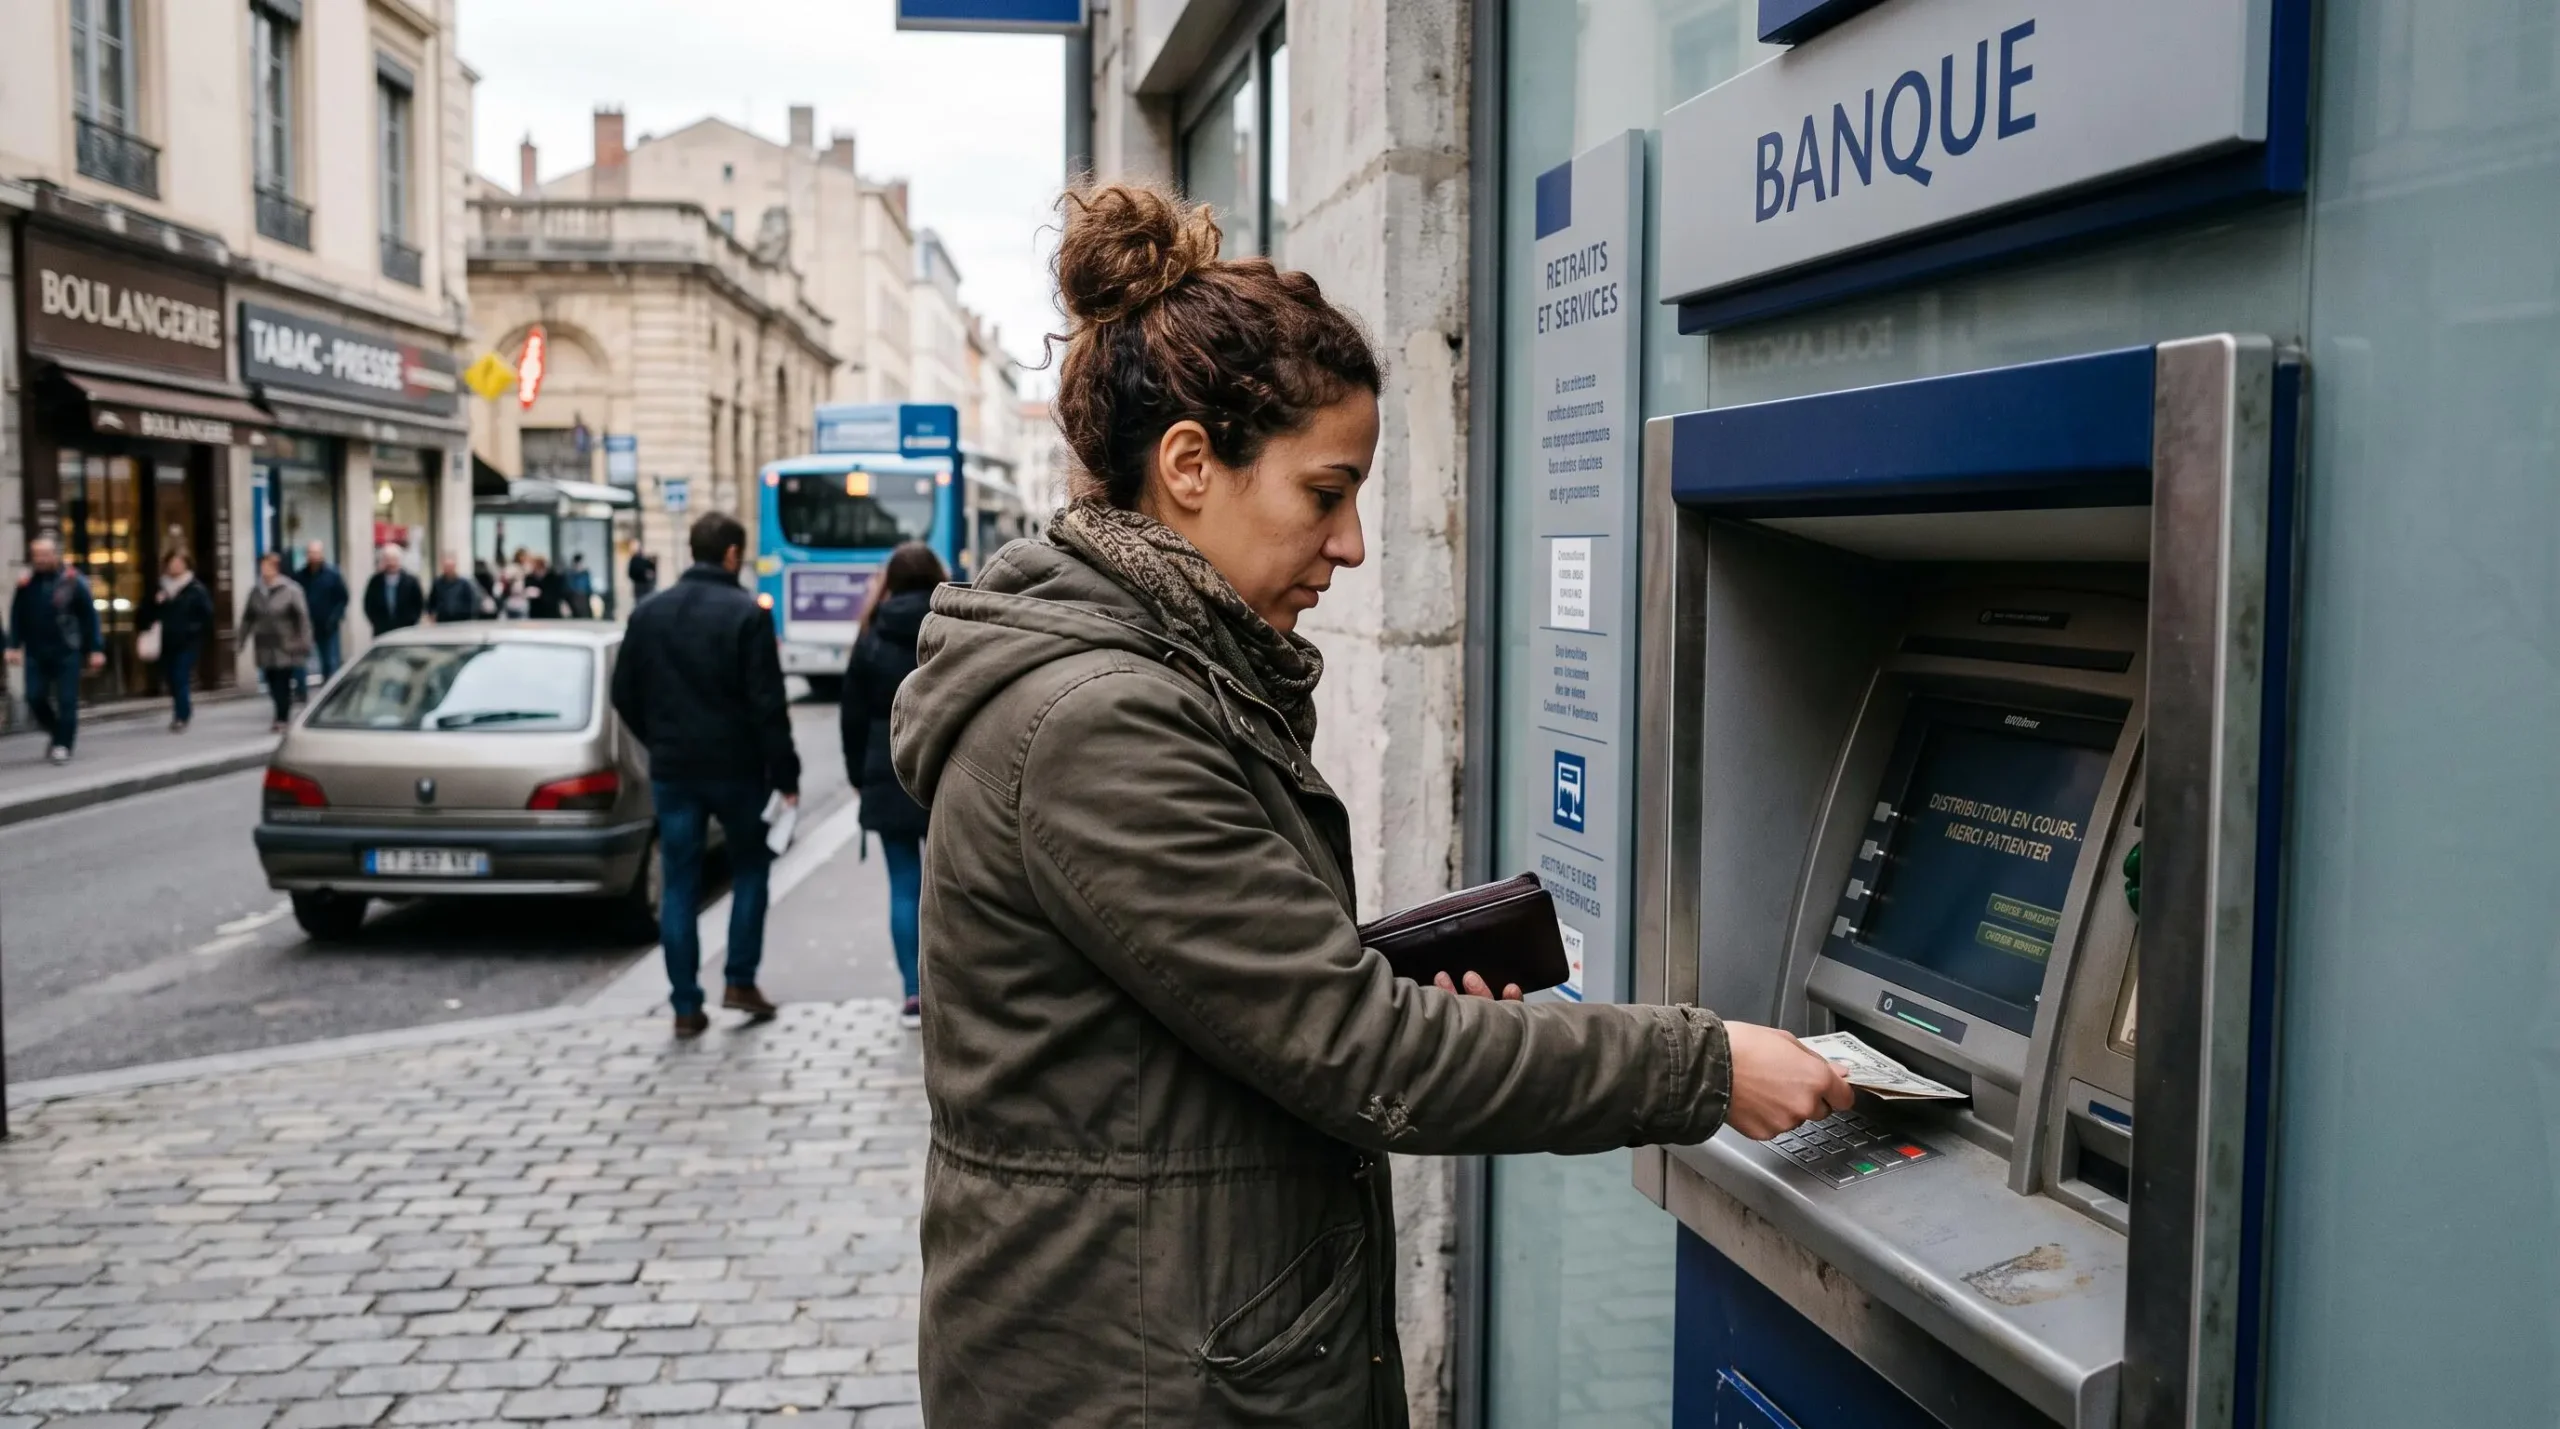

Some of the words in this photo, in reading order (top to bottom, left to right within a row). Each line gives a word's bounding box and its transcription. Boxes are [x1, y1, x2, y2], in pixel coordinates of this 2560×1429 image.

[1756, 18, 2036, 223] BANQUE
[1547, 240, 1608, 291] RETRAITS
[40, 268, 222, 350] BOULANGERIE
[1538, 303, 1552, 335] ET
[1555, 282, 1618, 330] SERVICES
[1929, 793, 2011, 825] DISTRIBUTION
[2011, 810, 2033, 830] EN
[1944, 822, 1982, 844] MERCI
[1983, 831, 2053, 862] PATIENTER
